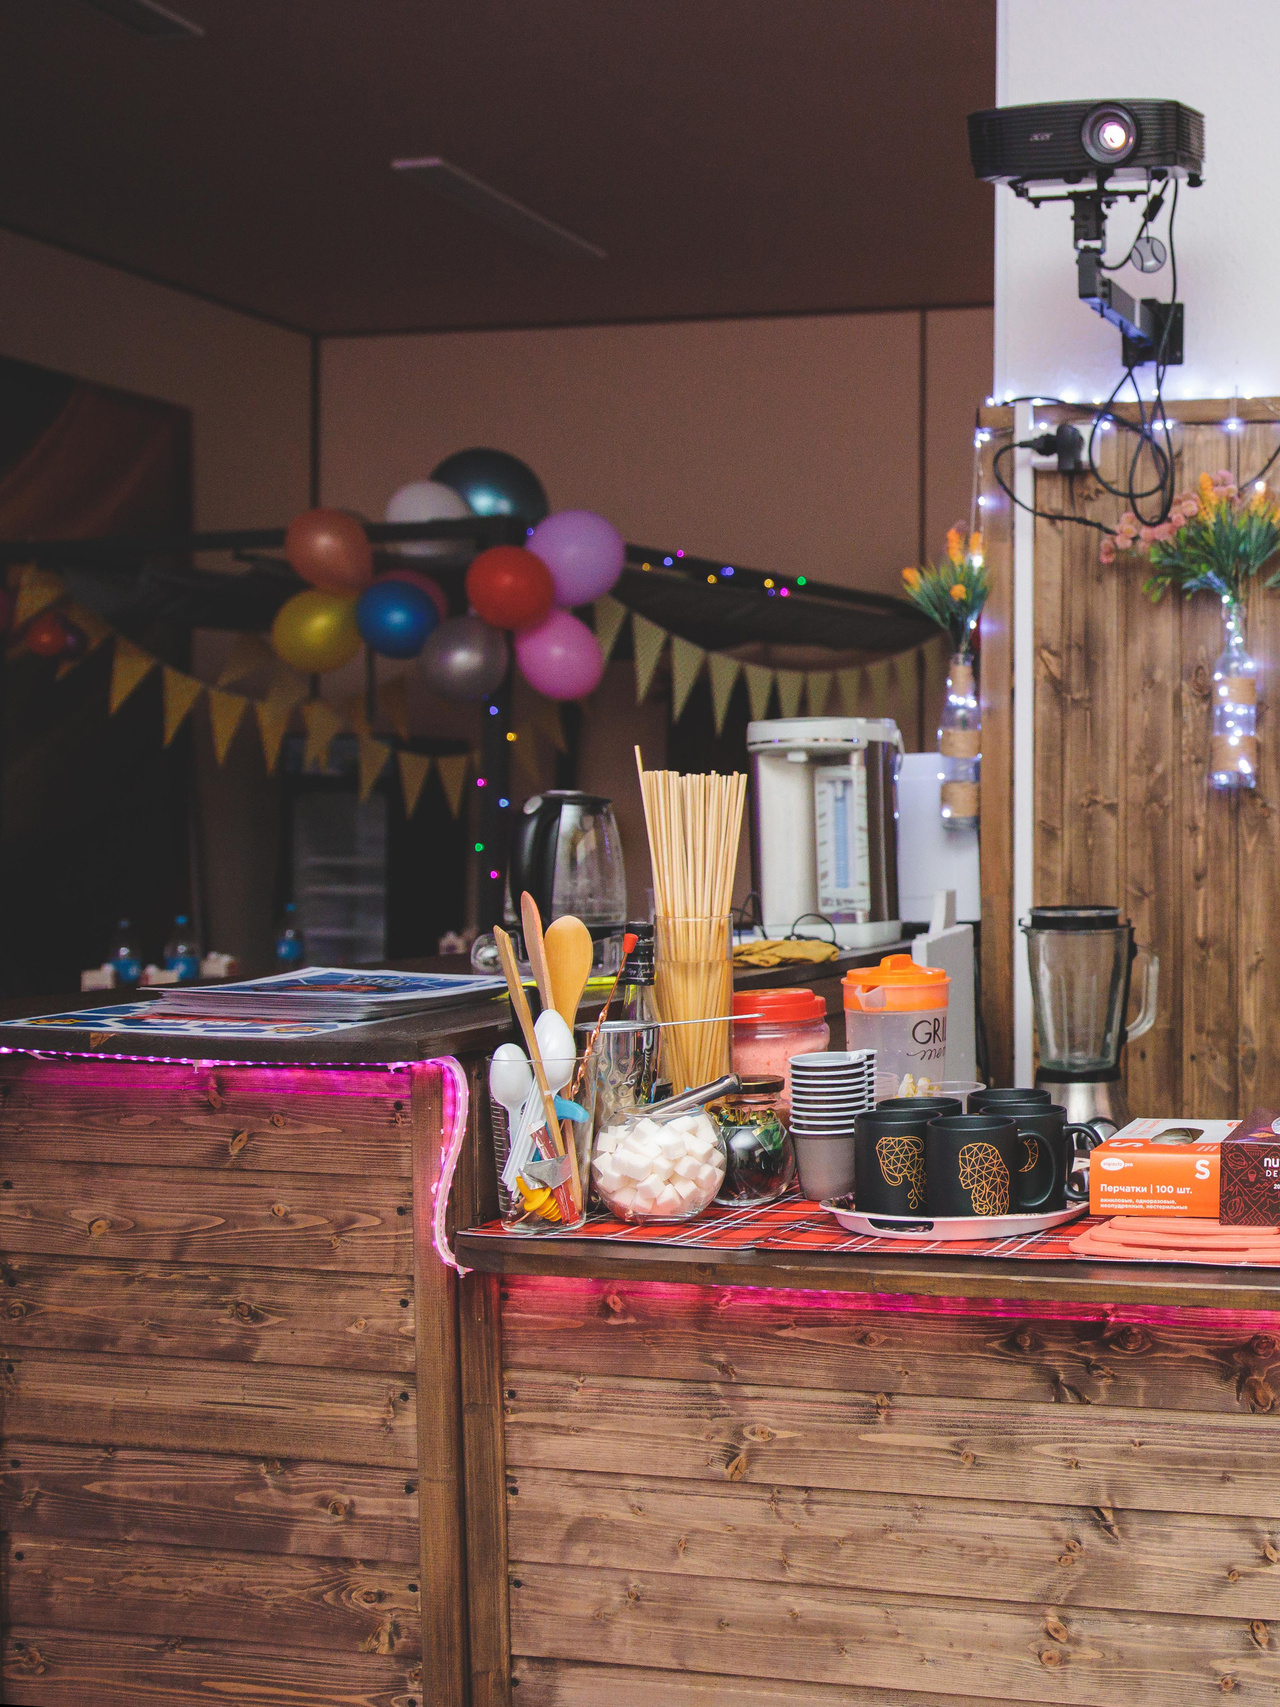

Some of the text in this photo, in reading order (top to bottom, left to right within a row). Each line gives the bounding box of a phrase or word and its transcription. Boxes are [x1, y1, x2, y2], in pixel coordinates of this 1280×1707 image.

[1194, 1159, 1211, 1180] S
[1100, 1184, 1193, 1194] Перчатки 100 шт.
